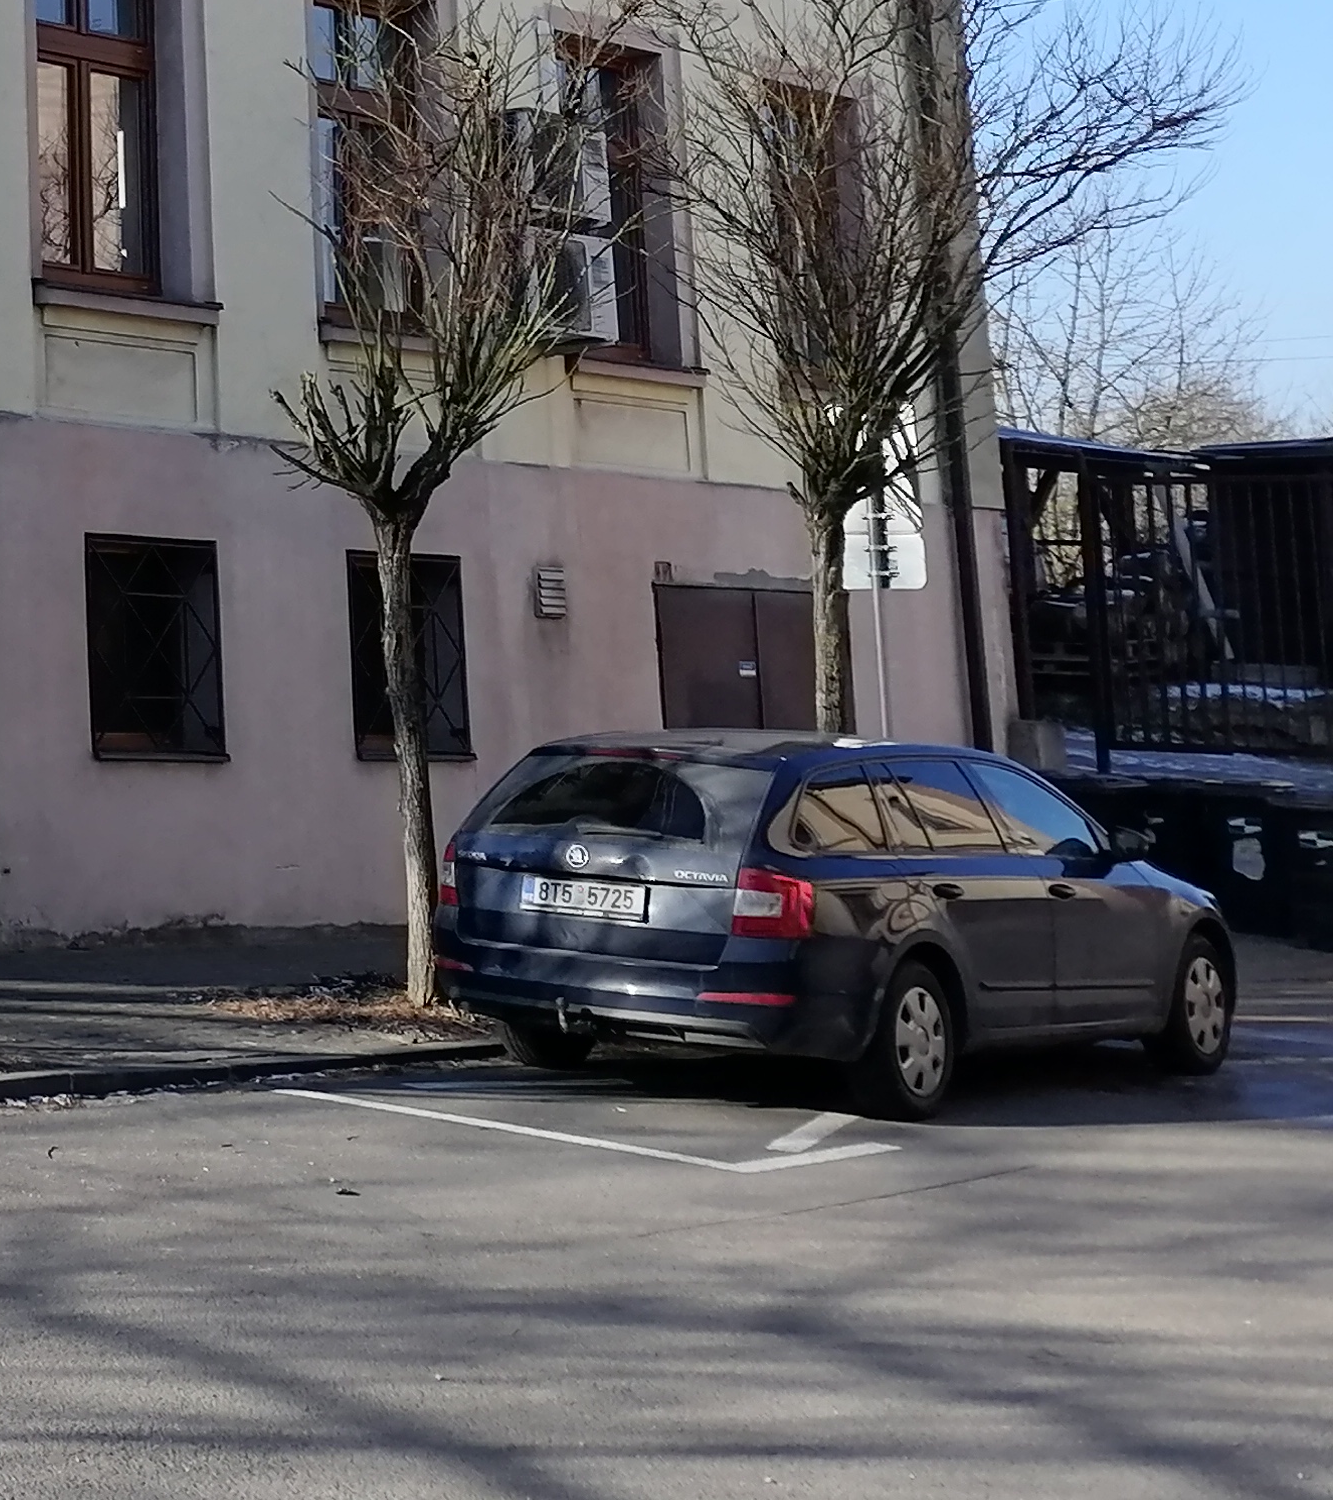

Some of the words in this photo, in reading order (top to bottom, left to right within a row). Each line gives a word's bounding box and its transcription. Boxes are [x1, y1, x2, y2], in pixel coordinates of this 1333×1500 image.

[673, 869, 728, 883] OCTAVIA
[539, 881, 573, 903] 8T5
[587, 886, 634, 910] 5725
